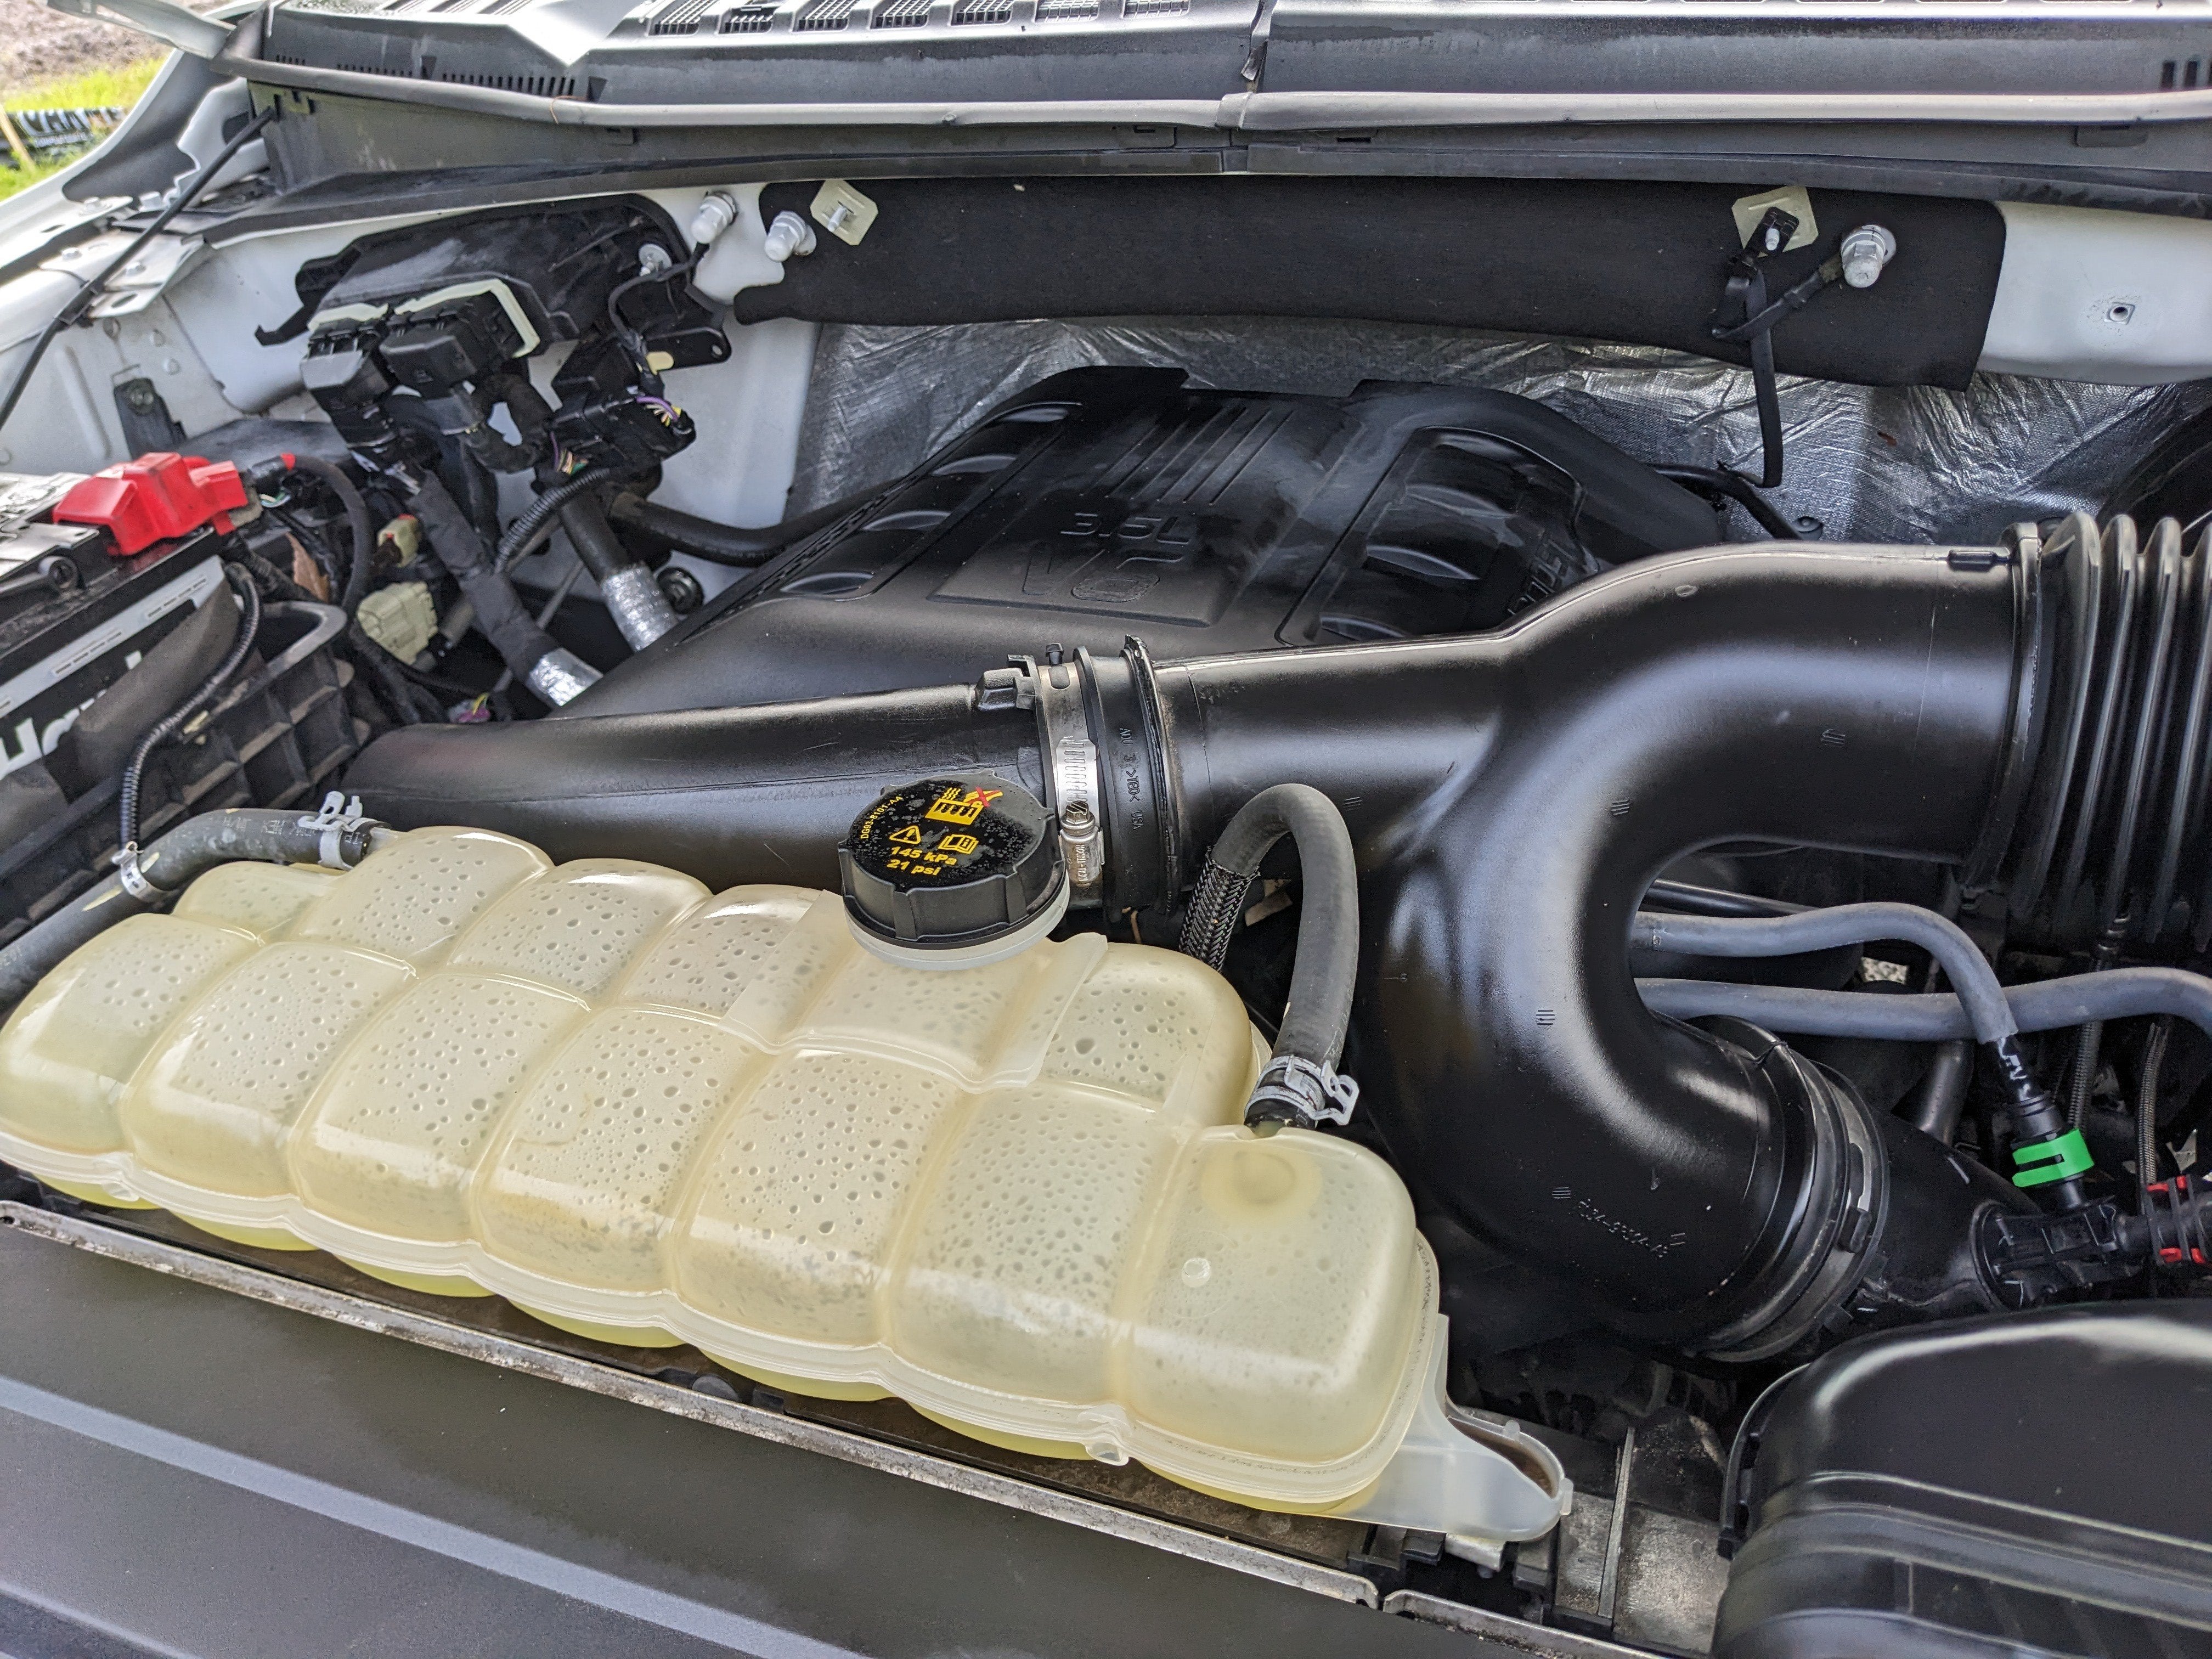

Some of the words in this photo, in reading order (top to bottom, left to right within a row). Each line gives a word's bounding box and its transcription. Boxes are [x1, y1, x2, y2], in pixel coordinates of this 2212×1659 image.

[1059, 512, 1192, 545] 3.5L
[860, 795, 904, 839] DG93-8101-AA
[1130, 810, 1144, 831] USA
[891, 847, 922, 859] 145
[923, 852, 957, 866] kPa
[887, 859, 910, 870] 21
[911, 865, 941, 876] psi
